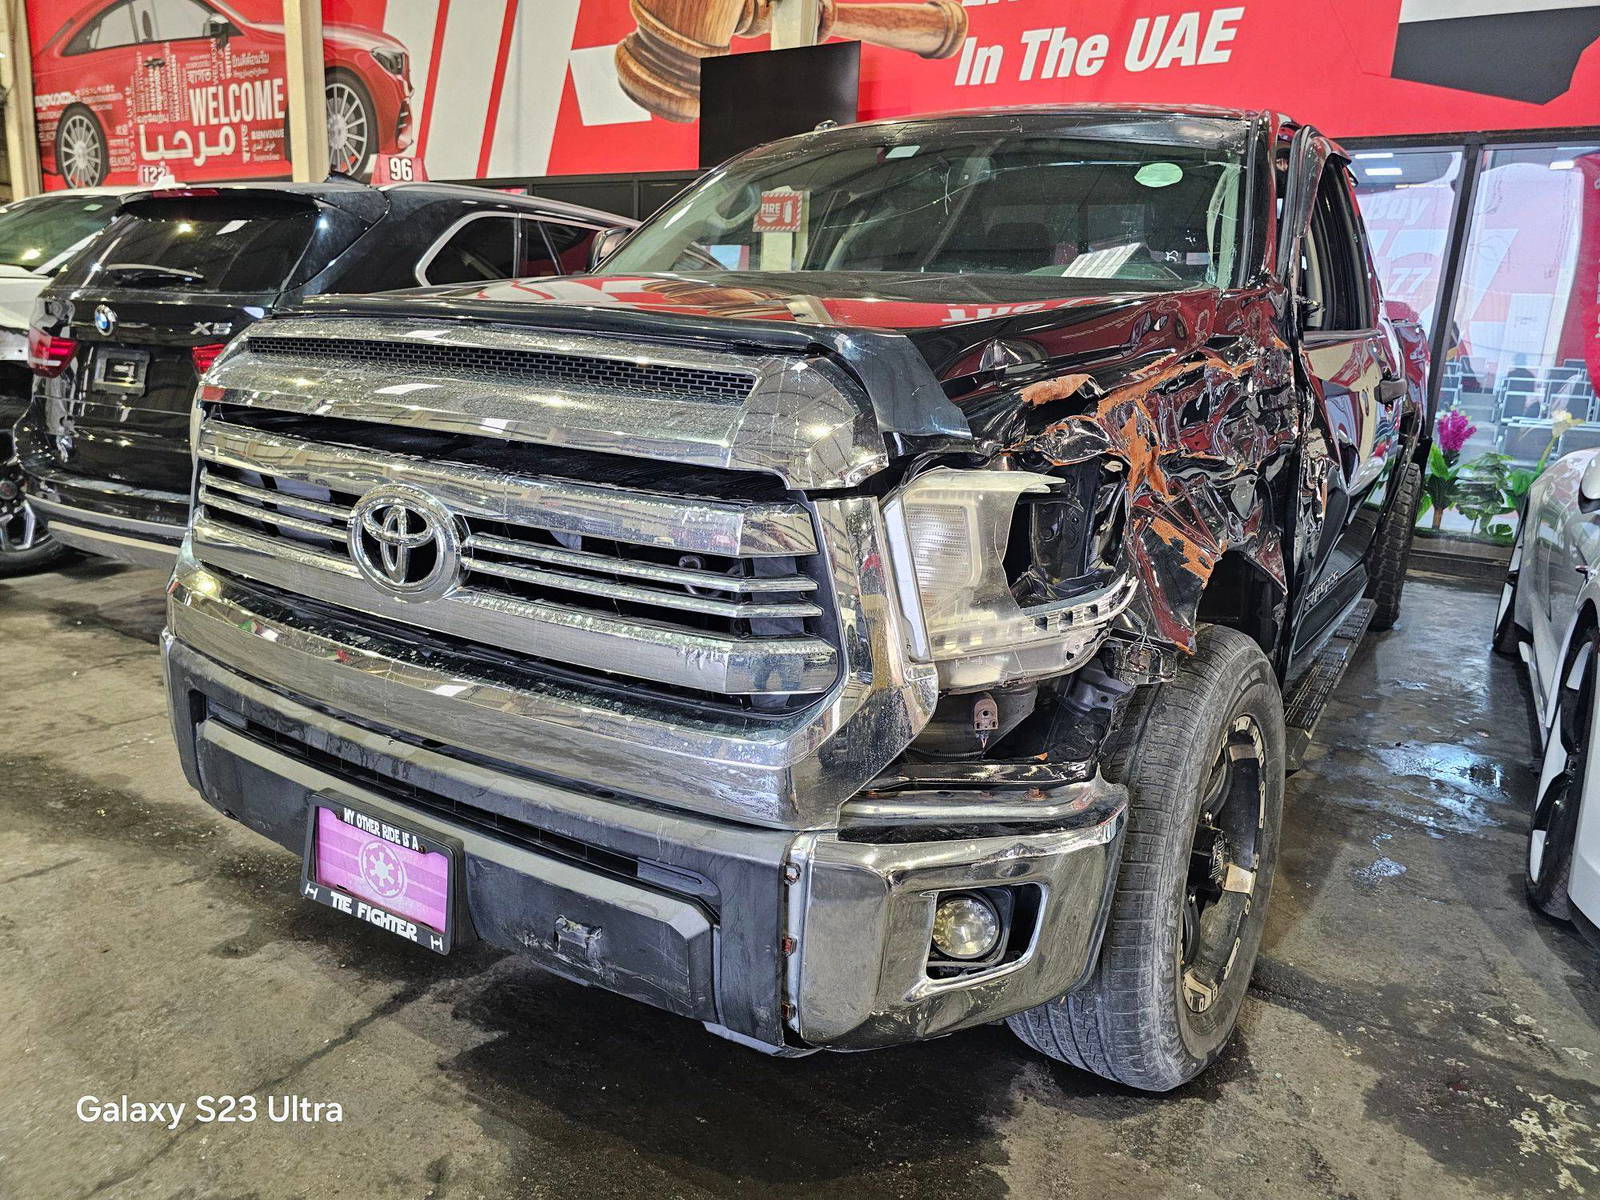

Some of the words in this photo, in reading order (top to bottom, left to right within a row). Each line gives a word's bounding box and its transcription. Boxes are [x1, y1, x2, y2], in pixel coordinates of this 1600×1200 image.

[954, 37, 1004, 86] In
[1018, 27, 1109, 82] The
[1124, 7, 1245, 72] UAE
[188, 78, 286, 127] WELCOME
[139, 123, 237, 167] مرحبا
[389, 156, 413, 181] 96
[760, 203, 781, 215] FIRE
[1388, 266, 1432, 294] 77
[190, 321, 233, 336] X5
[343, 807, 356, 822] MY
[356, 813, 381, 833] OTHER
[382, 822, 401, 844] RIDE
[401, 831, 410, 848] IS
[412, 835, 419, 851] A
[330, 891, 353, 914] TIE
[357, 902, 418, 943] FIGHTER
